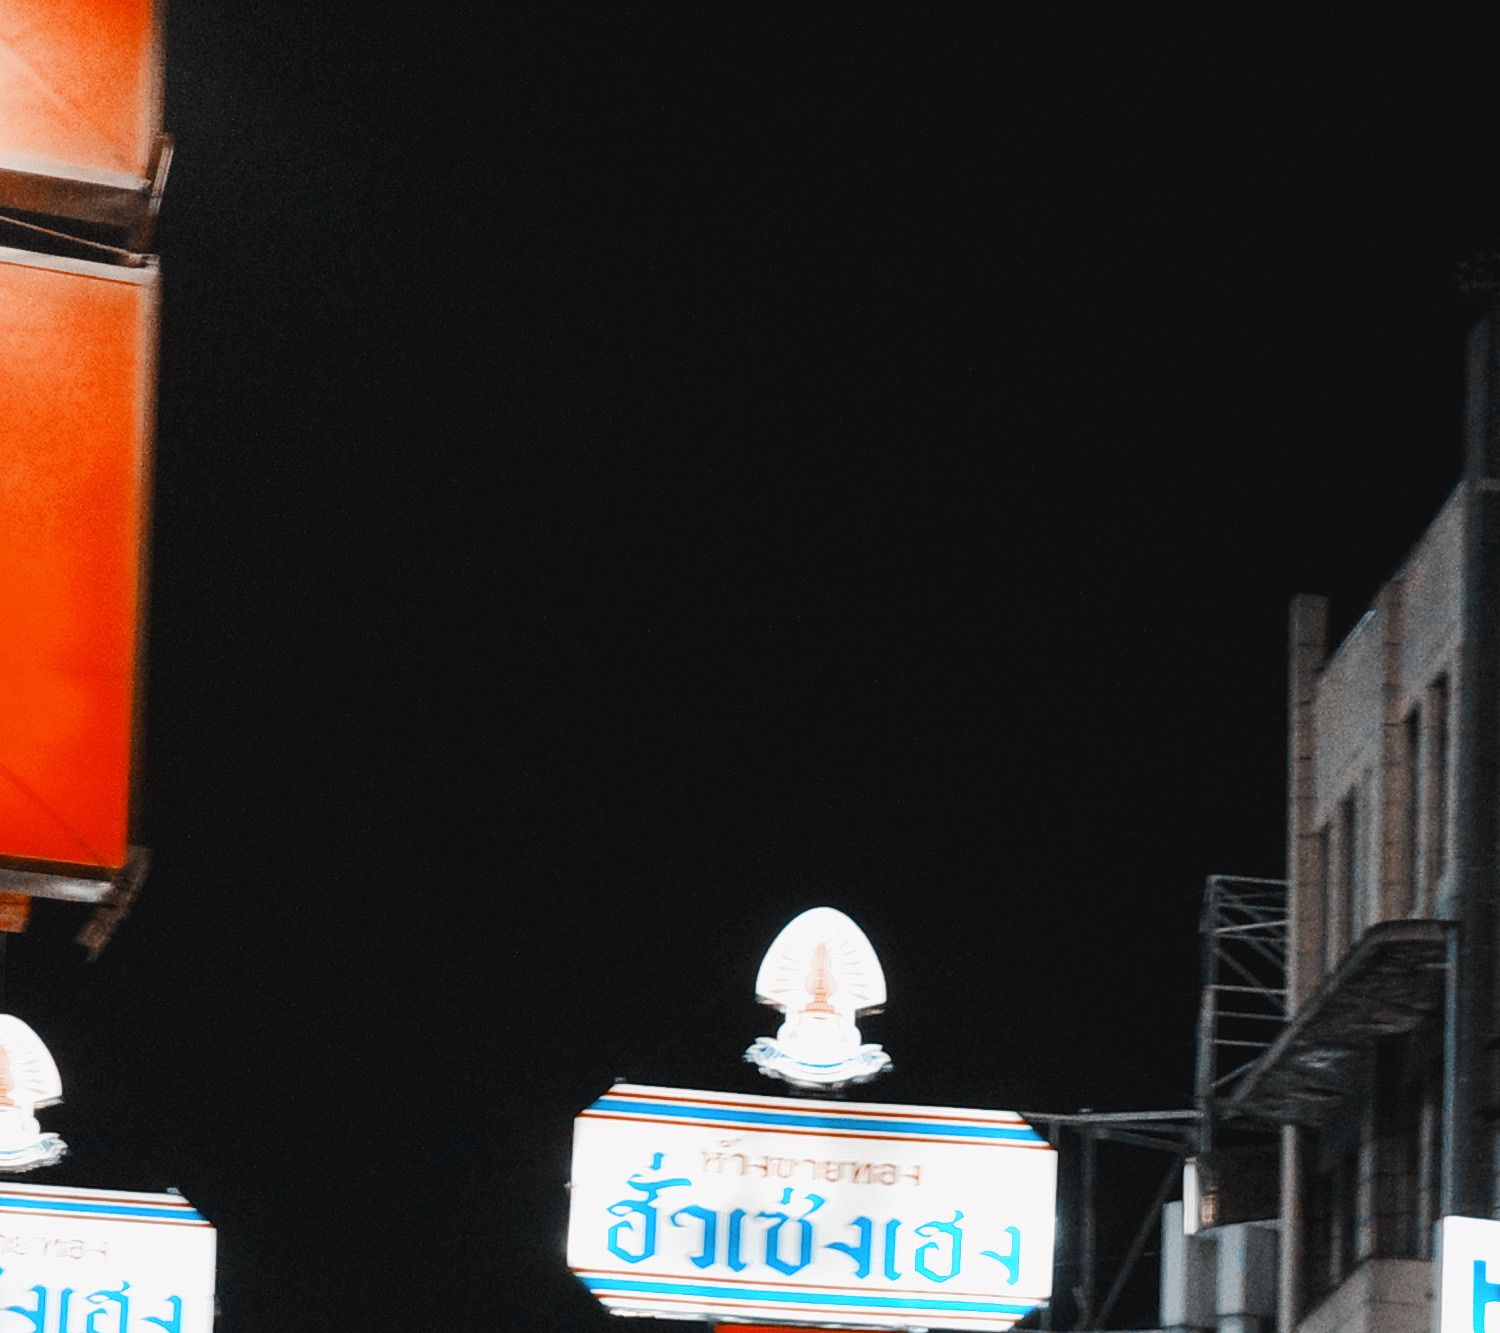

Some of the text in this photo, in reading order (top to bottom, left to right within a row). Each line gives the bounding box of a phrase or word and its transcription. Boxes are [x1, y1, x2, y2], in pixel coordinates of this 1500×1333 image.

[607, 1152, 1021, 1286] ฮั่วเซ่งเฮง
